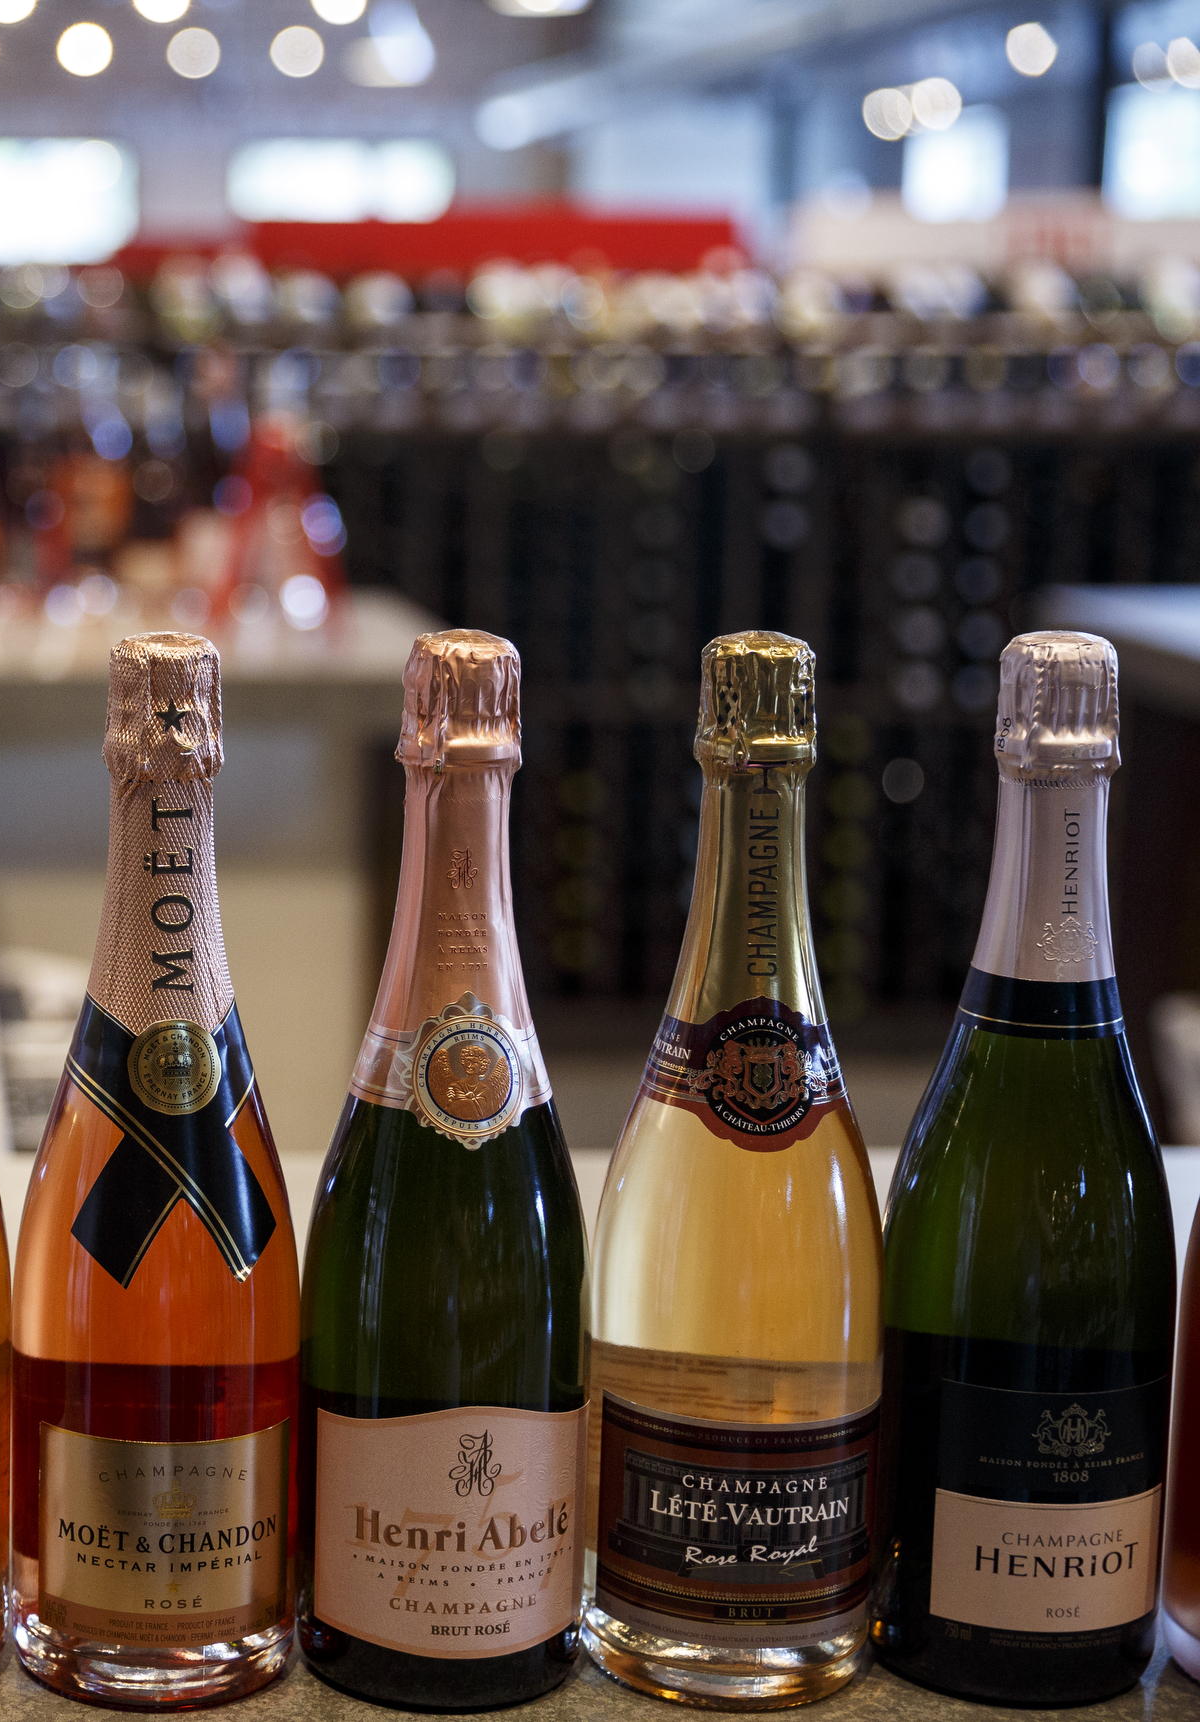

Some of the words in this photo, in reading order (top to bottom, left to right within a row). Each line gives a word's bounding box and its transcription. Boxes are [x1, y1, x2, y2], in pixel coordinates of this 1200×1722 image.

[997, 717, 1012, 752] 1808
[1062, 807, 1080, 914] HENRIOT
[144, 795, 194, 994] MOËT
[747, 807, 780, 977] CHAMPAGNE
[438, 911, 488, 920] MAISON
[449, 944, 489, 954] REIMS
[437, 962, 454, 971] EN
[461, 962, 489, 971] 1757
[454, 1033, 485, 1043] REIMS
[719, 1018, 799, 1041] CHAMPAGNE
[171, 1034, 206, 1058] CHANDON
[418, 1024, 461, 1087] CHAMPAGNE
[470, 1023, 504, 1042] HENRI
[182, 1072, 207, 1099] FRANCE
[436, 1110, 479, 1130] DEPUIS
[488, 1110, 508, 1128] 1757
[722, 1105, 806, 1133] CHÂTEAU-THIERRY
[698, 1433, 750, 1444] PRODUCE
[774, 1435, 813, 1444] FRANCE
[980, 1455, 1021, 1467] MAISON
[1084, 1458, 1112, 1468] REIMS
[1115, 1452, 1145, 1464] FRANCE
[98, 1465, 248, 1482] CHAMPAGNE
[1053, 1470, 1089, 1483] 1808
[682, 1474, 828, 1494] CHAMPAGNE
[198, 1507, 230, 1516] FRANCE
[650, 1489, 850, 1526] LÉTÉ-VAUTRAIN
[57, 1518, 130, 1551] MOËT
[135, 1536, 152, 1554] &
[158, 1514, 278, 1554] CHANDON
[354, 1505, 466, 1552] Henri
[477, 1502, 569, 1551] Abelé
[1001, 1529, 1123, 1548] CHAMPAGNE
[365, 1554, 430, 1571] MAISON
[441, 1562, 506, 1573] FONDÉE
[515, 1558, 532, 1568] EN
[540, 1548, 565, 1562] 1757
[685, 1546, 738, 1566] Rose
[750, 1535, 818, 1566] Royal
[975, 1542, 1139, 1578] HENRIOT
[77, 1552, 156, 1573] NECTAR
[170, 1550, 262, 1573] IMPÉRIAL
[397, 1575, 450, 1588] REIMS
[497, 1567, 553, 1585] FRANCE
[144, 1596, 202, 1609] ROSÉ
[389, 1594, 537, 1615] CHAMPAGNE
[728, 1607, 775, 1618] BRUT
[1046, 1605, 1080, 1618] ROSÉ
[73, 1622, 98, 1636] PRODUCED
[99, 1629, 106, 1637] BY
[106, 1630, 137, 1641] CHAMPAGNE
[160, 1634, 186, 1642] CHANDON
[218, 1628, 236, 1638] FRANCE
[109, 1619, 134, 1628] PRODUIT
[135, 1622, 143, 1630] DE
[145, 1622, 168, 1631] FRANCE
[177, 1621, 204, 1631] PRODUCT
[206, 1620, 213, 1628] OF
[215, 1616, 235, 1627] FRANCE
[430, 1624, 471, 1636] BRUT
[475, 1621, 510, 1636] ROSÉ
[662, 1626, 700, 1639] CHAMPAGNE
[810, 1630, 828, 1639] FRANCE
